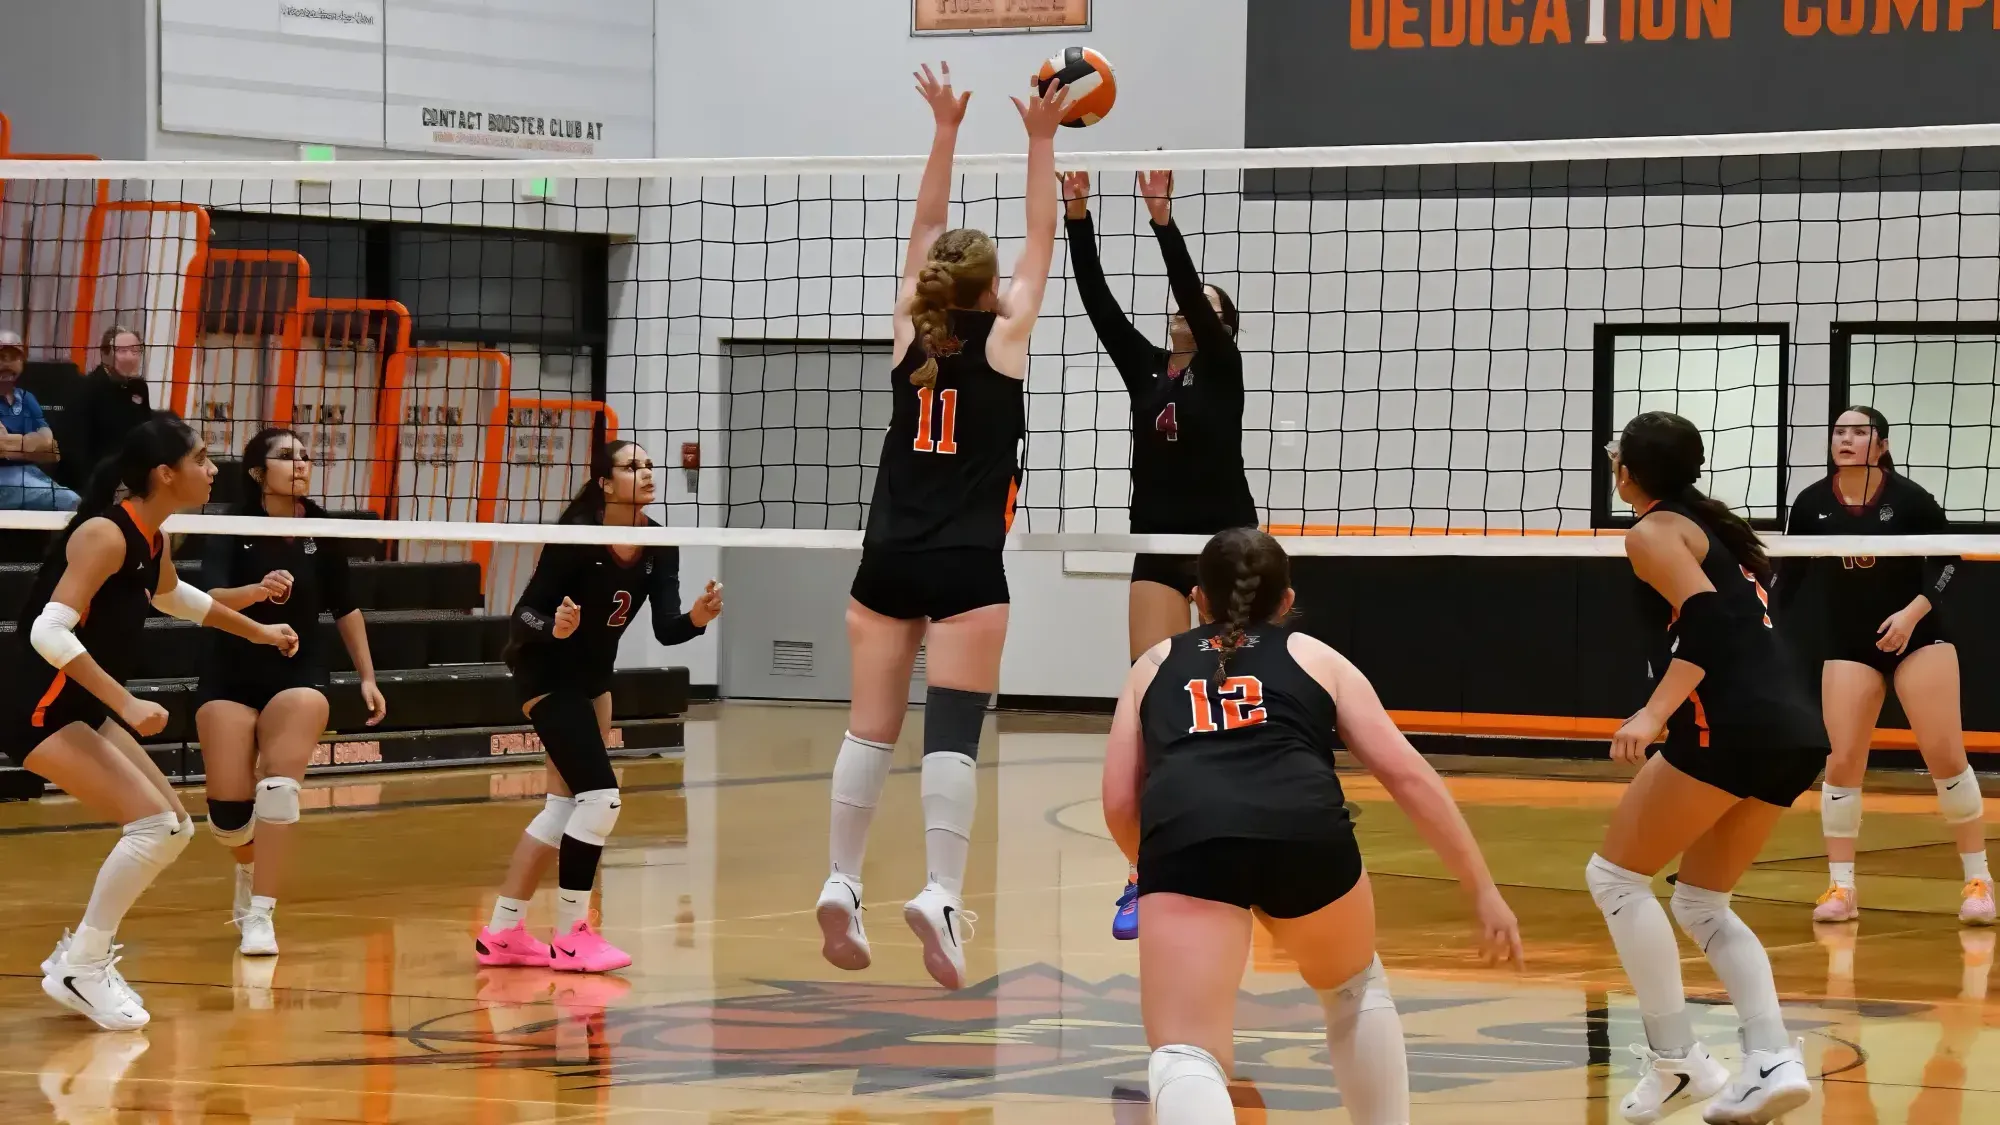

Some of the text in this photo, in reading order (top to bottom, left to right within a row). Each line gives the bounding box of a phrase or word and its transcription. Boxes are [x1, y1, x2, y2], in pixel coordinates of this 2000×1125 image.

[1350, 0, 1732, 49] DEDICATION
[422, 107, 604, 140] CONTACT BOOSTER CLUB AT
[913, 387, 957, 454] 11
[1156, 402, 1178, 441] 4
[607, 590, 632, 626] 2
[1184, 675, 1267, 733] 12
